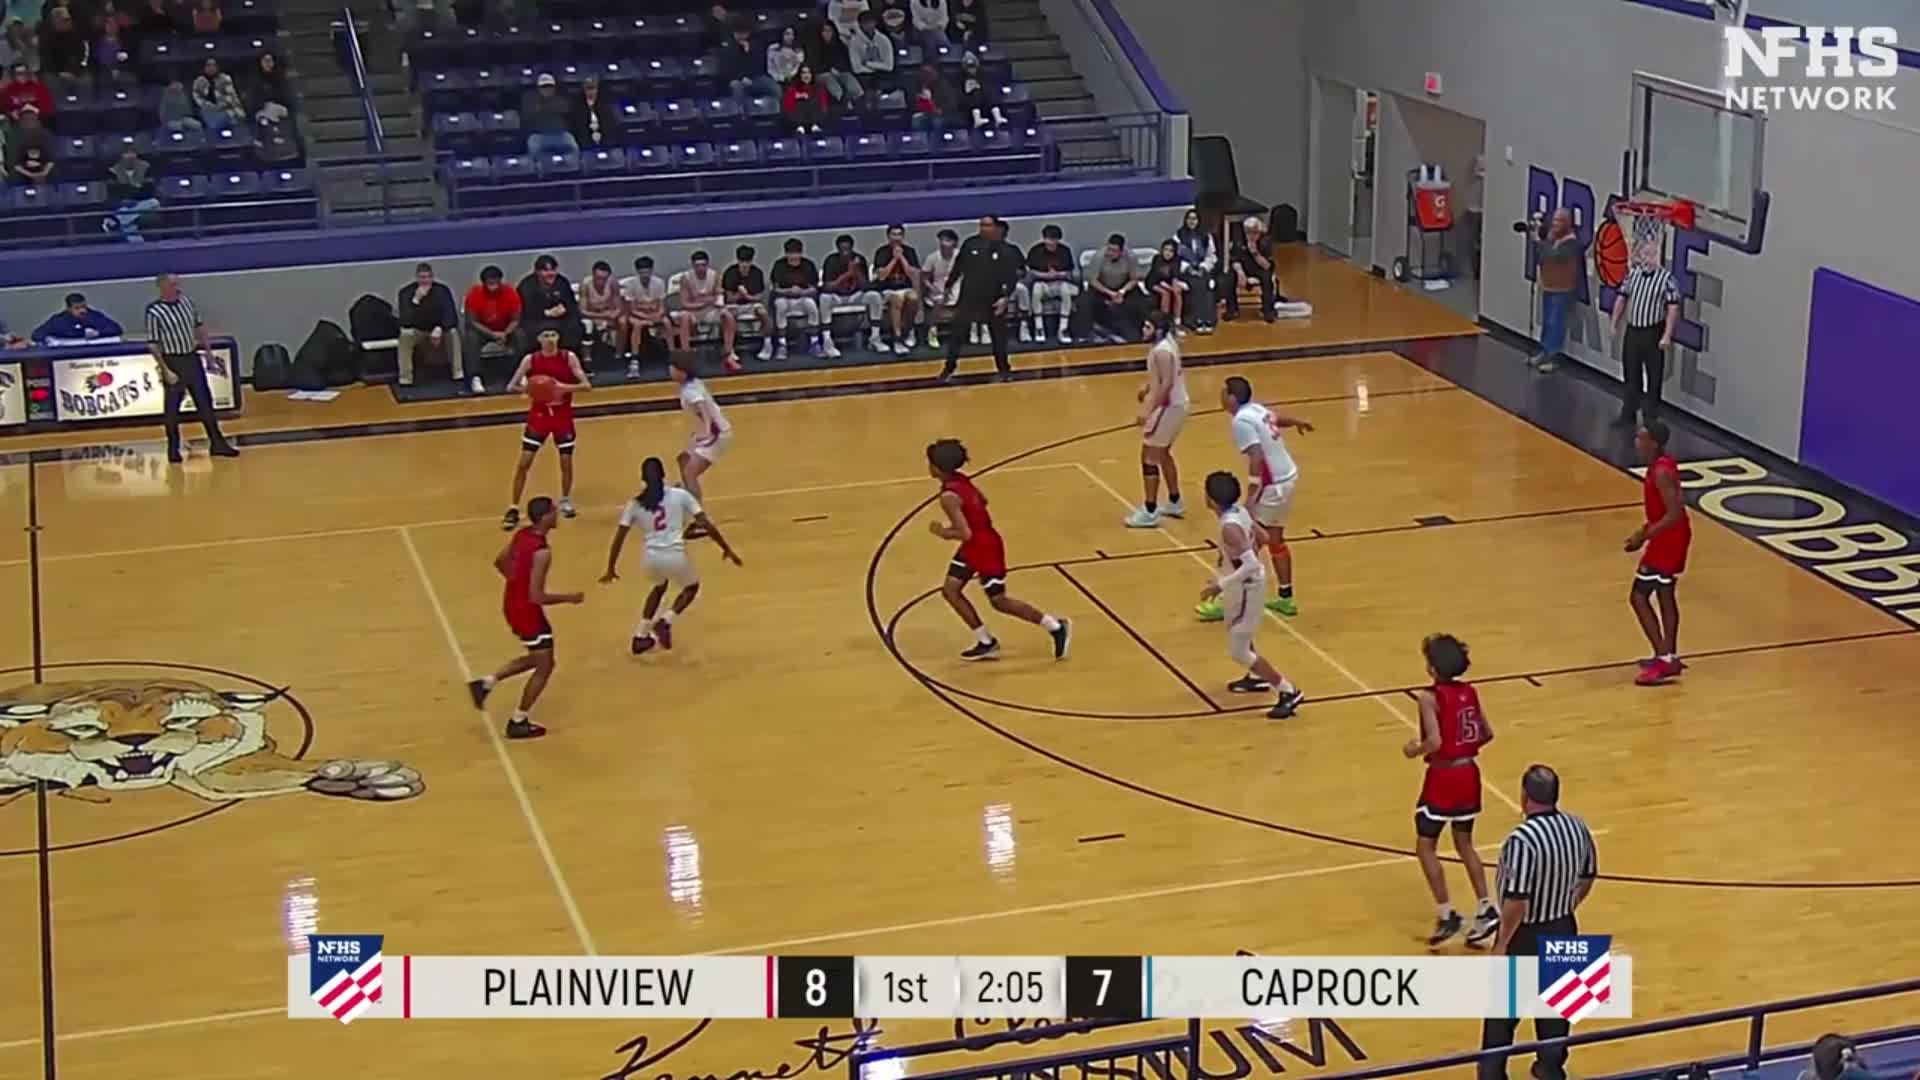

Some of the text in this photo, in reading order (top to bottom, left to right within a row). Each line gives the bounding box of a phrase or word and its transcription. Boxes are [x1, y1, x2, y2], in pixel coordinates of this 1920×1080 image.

[60, 380, 139, 416] BOBCATS
[654, 505, 668, 532] 2
[1455, 705, 1479, 746] 15
